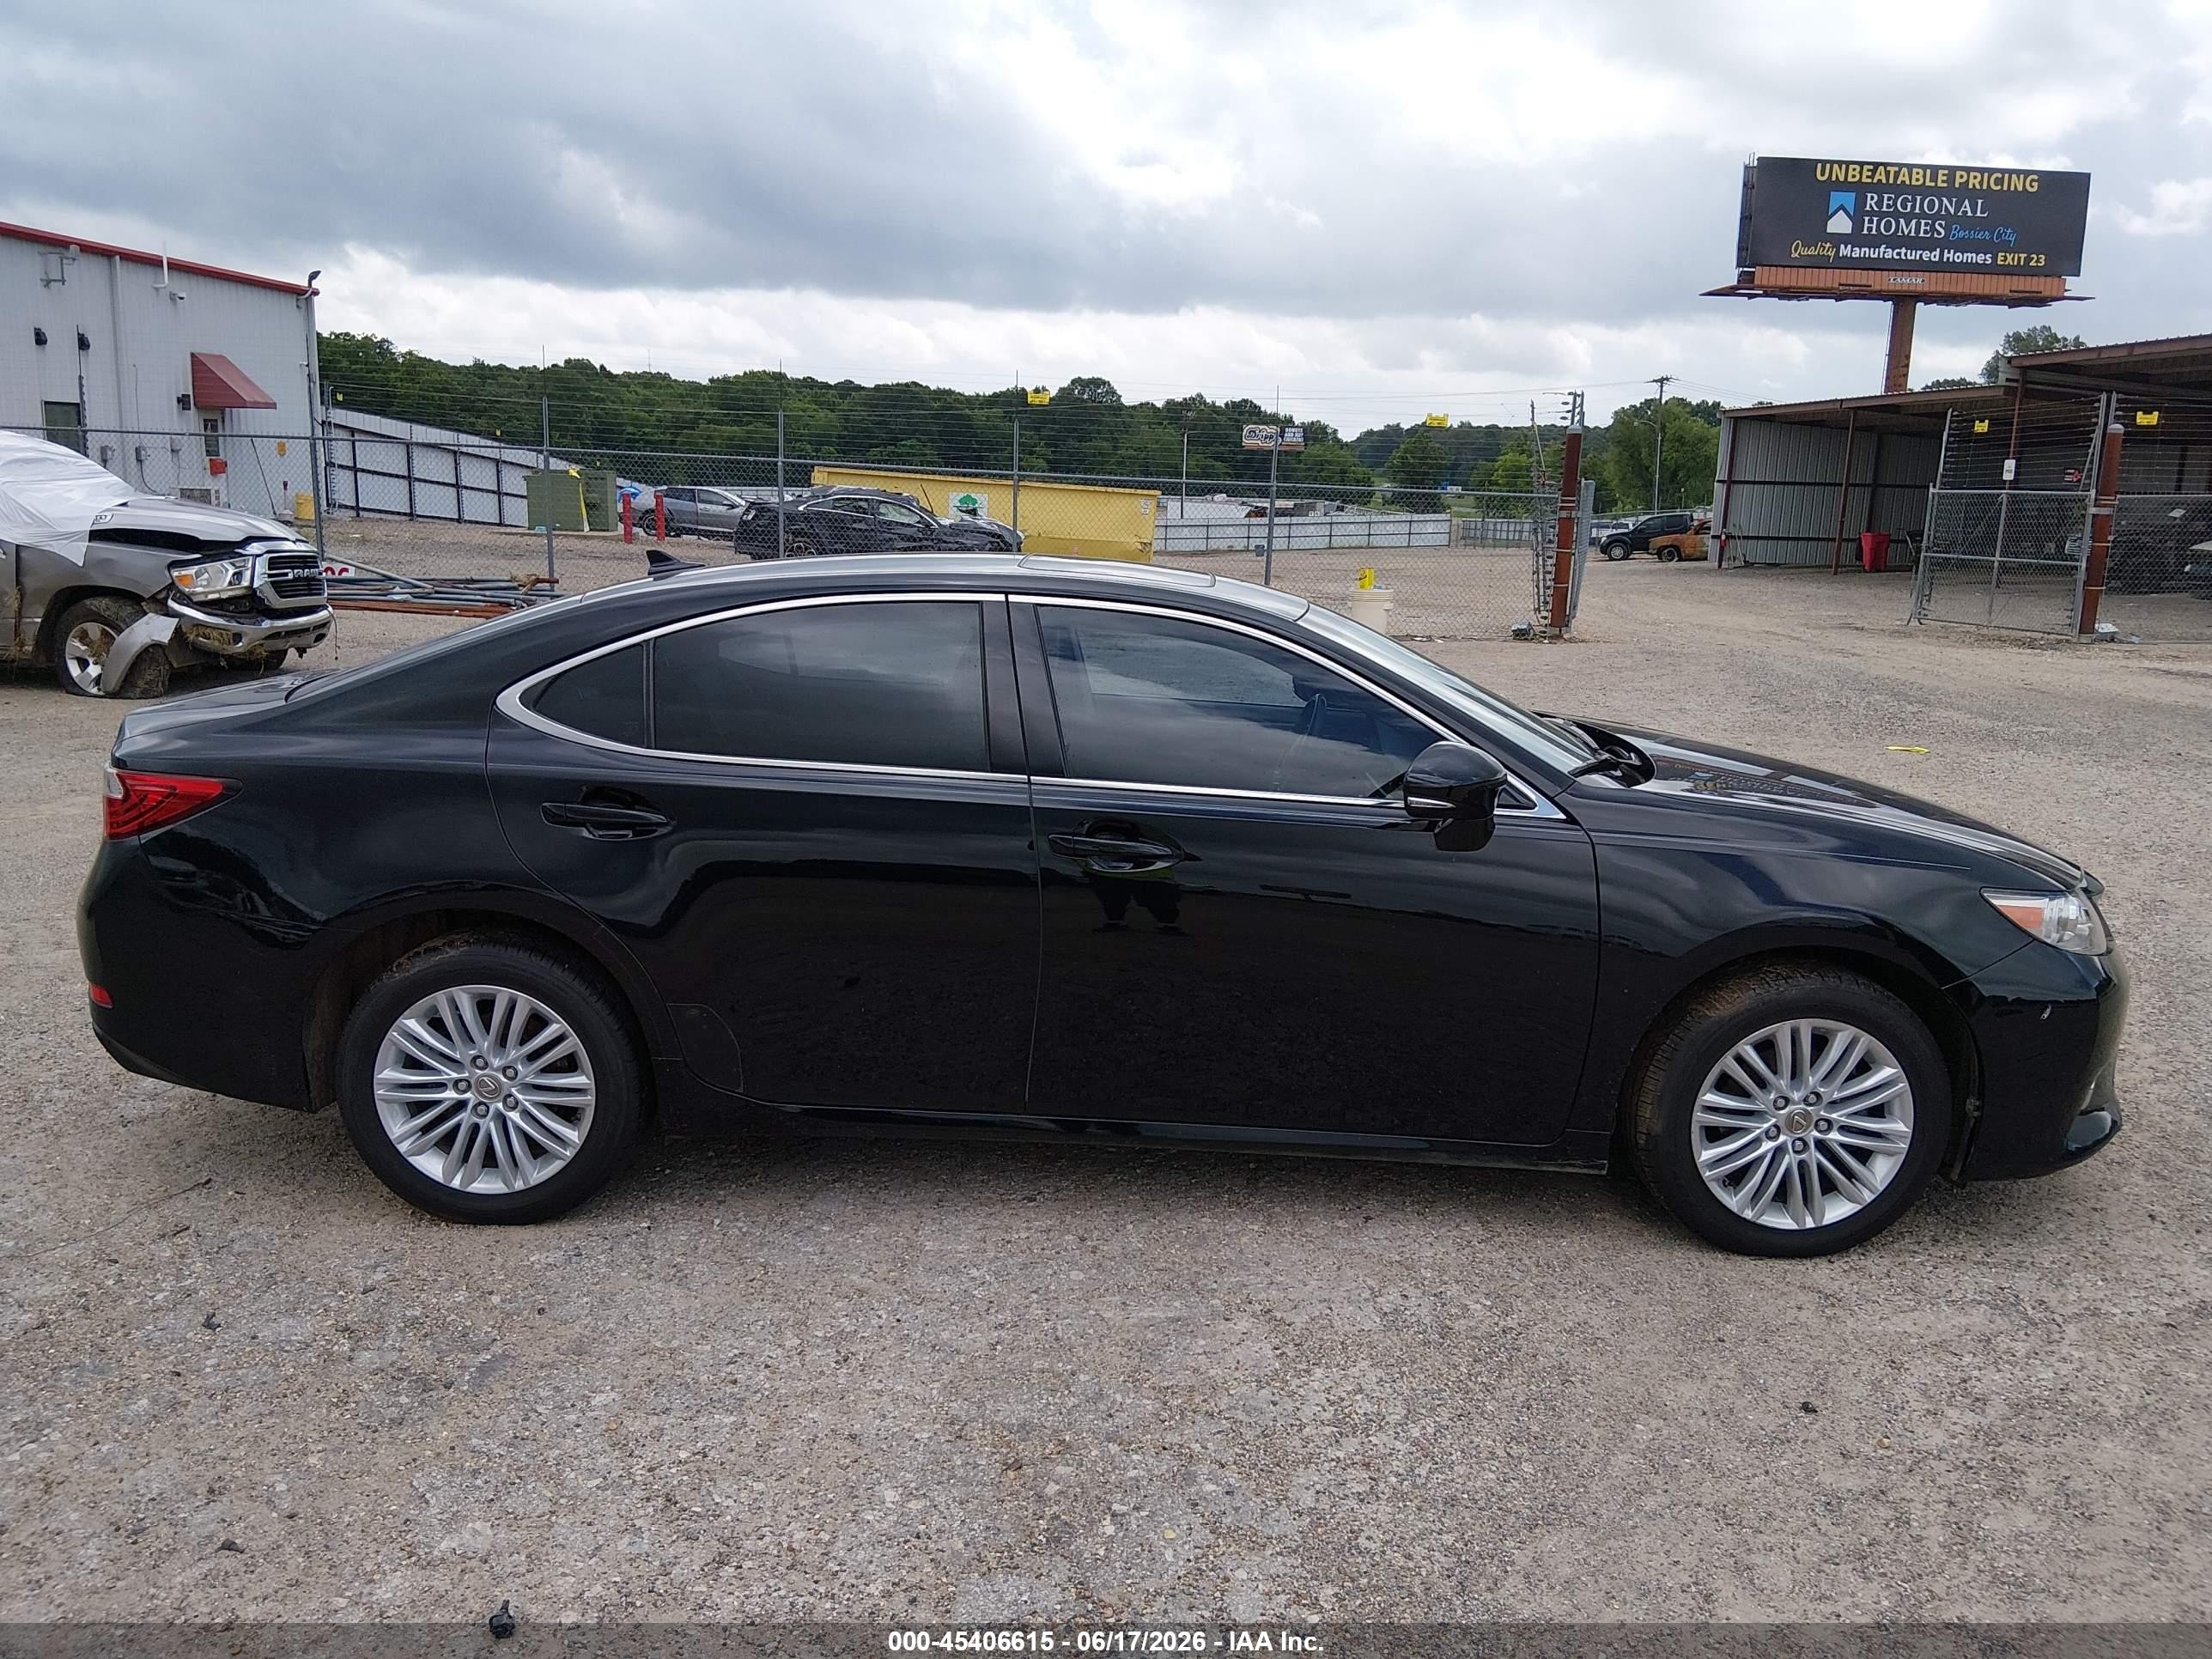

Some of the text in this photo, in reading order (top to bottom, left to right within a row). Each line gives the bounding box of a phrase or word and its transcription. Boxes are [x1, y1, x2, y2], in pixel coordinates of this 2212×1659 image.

[1815, 162, 2039, 192] UNBEATABLE PRICING
[1863, 192, 1989, 217] REGIONAL
[1861, 216, 1946, 239] HOMES
[1949, 224, 2017, 247] Bossier City
[1790, 240, 2045, 266] Quality Manufactured Homes EXIT 23
[1246, 429, 1275, 442] Dripp
[294, 568, 319, 578] RAM
